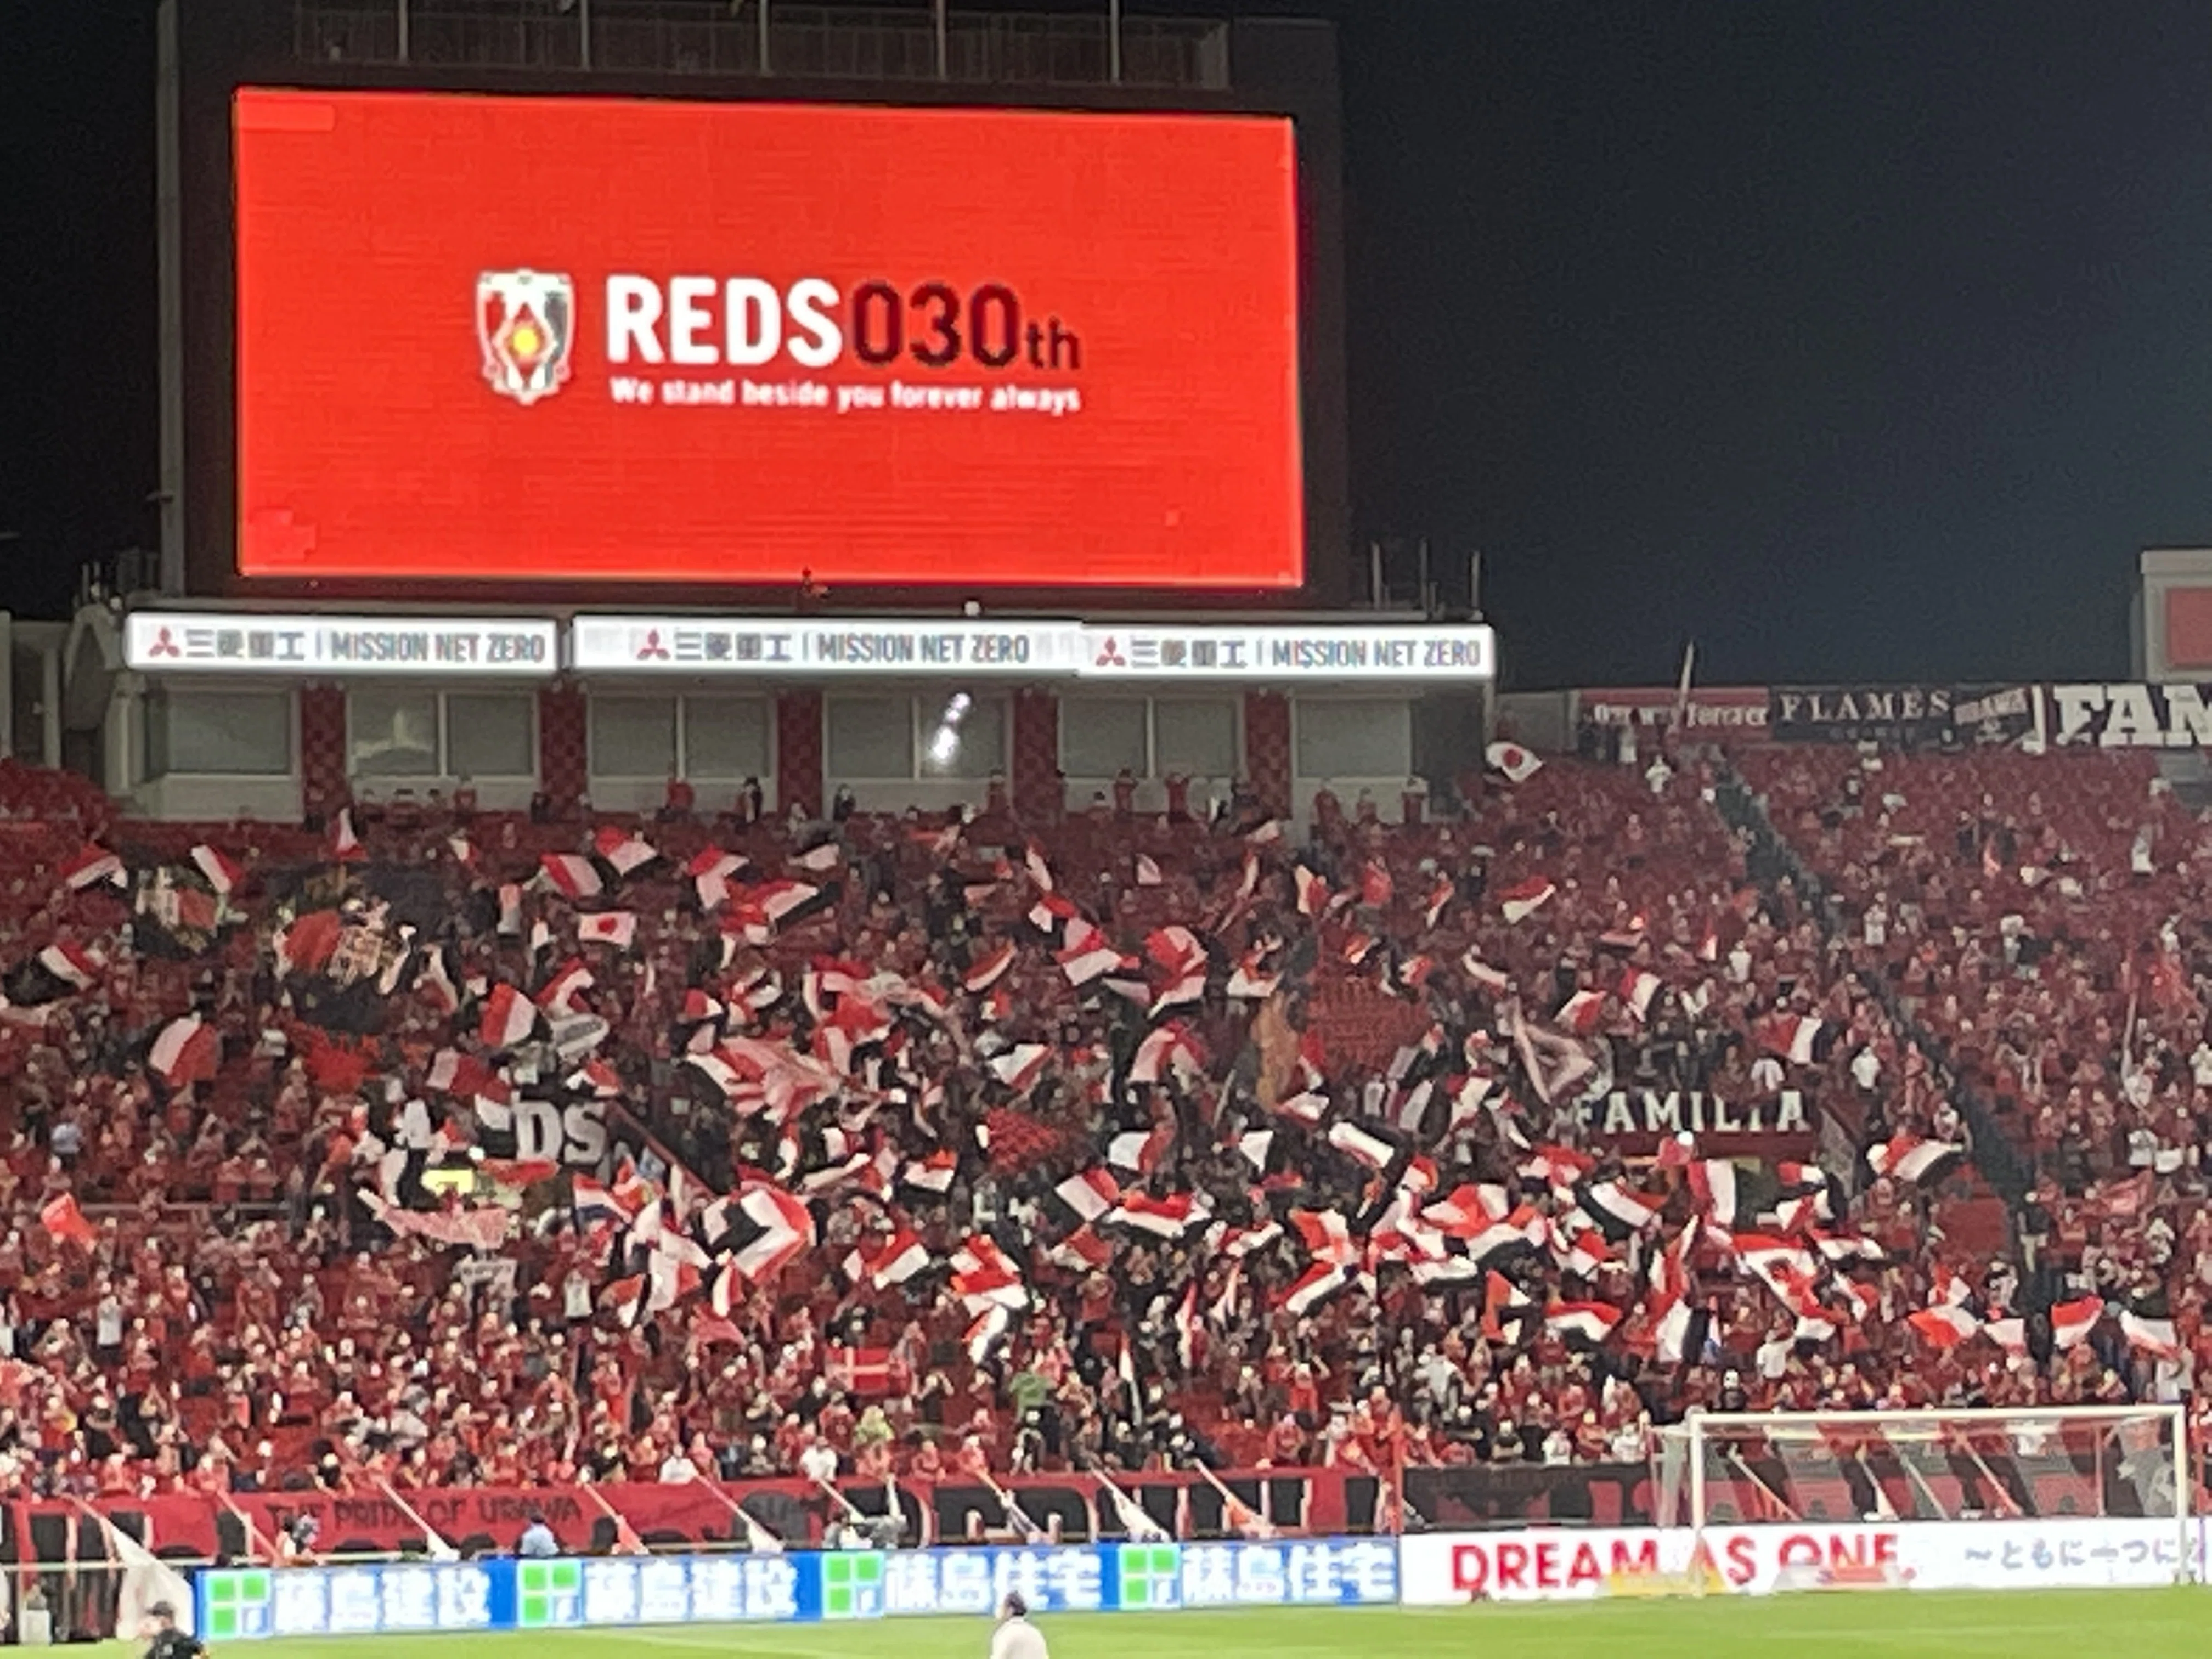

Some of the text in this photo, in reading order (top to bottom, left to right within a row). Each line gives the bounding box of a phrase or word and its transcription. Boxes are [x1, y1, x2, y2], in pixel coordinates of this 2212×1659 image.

[609, 376, 1080, 417] We stand beside you forever always
[331, 631, 428, 661] MISSION
[435, 633, 481, 662] NET
[486, 633, 546, 663] ZERO
[817, 631, 913, 663] MISSION
[919, 634, 965, 663] NET
[969, 634, 1030, 664] ZERO
[1271, 639, 1367, 668] MISSION
[1373, 639, 1417, 668] NET
[1424, 639, 1481, 668] ZERO
[1779, 689, 1951, 721] FLAMES
[1451, 1539, 1658, 1590] DREAM
[1689, 1534, 1757, 1586] AS
